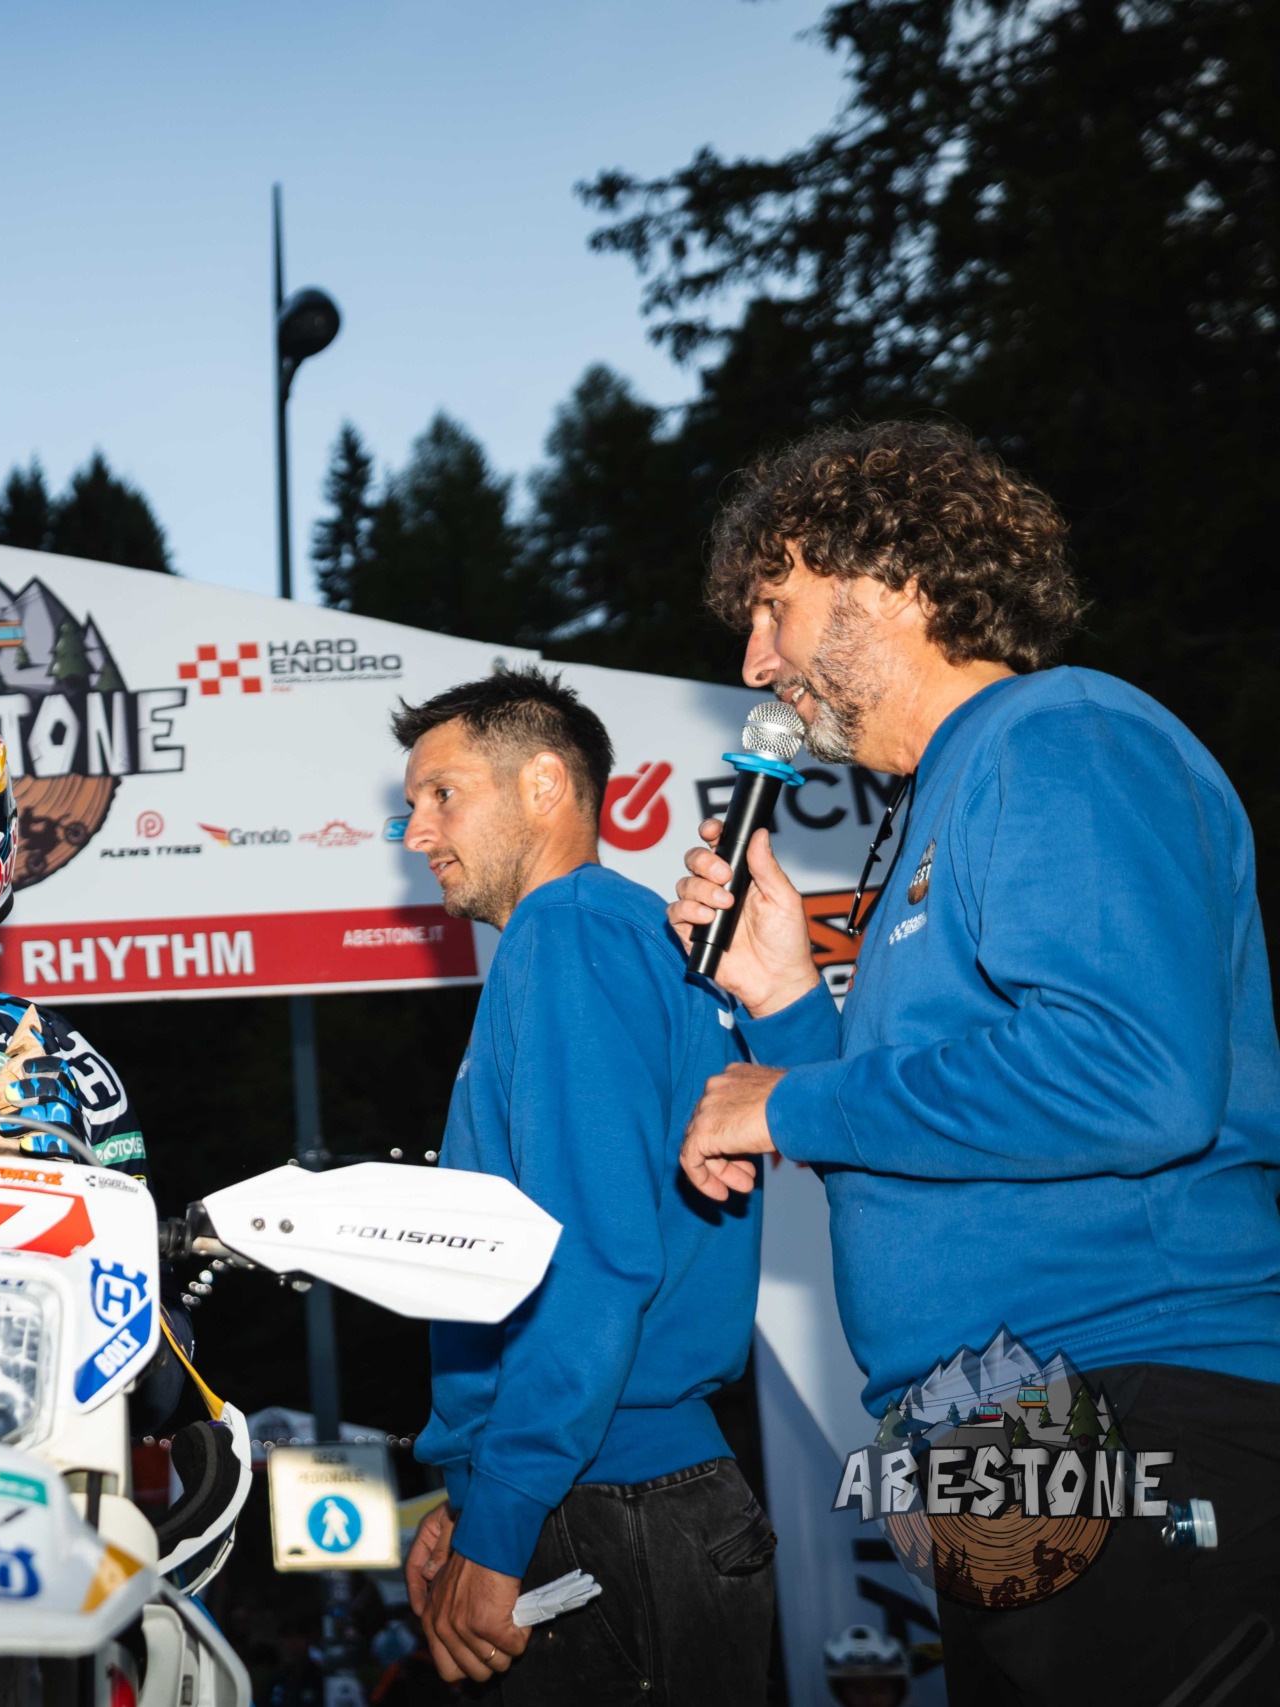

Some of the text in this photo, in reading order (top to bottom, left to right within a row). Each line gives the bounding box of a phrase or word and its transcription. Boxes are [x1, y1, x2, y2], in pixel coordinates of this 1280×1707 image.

[268, 638, 357, 656] HARD
[270, 654, 402, 674] ENDURO
[100, 844, 203, 858] PLEWS TYRES
[342, 925, 444, 948] ABESTONE.IT
[21, 930, 255, 984] RHYTHM
[94, 1330, 142, 1381] BOLT
